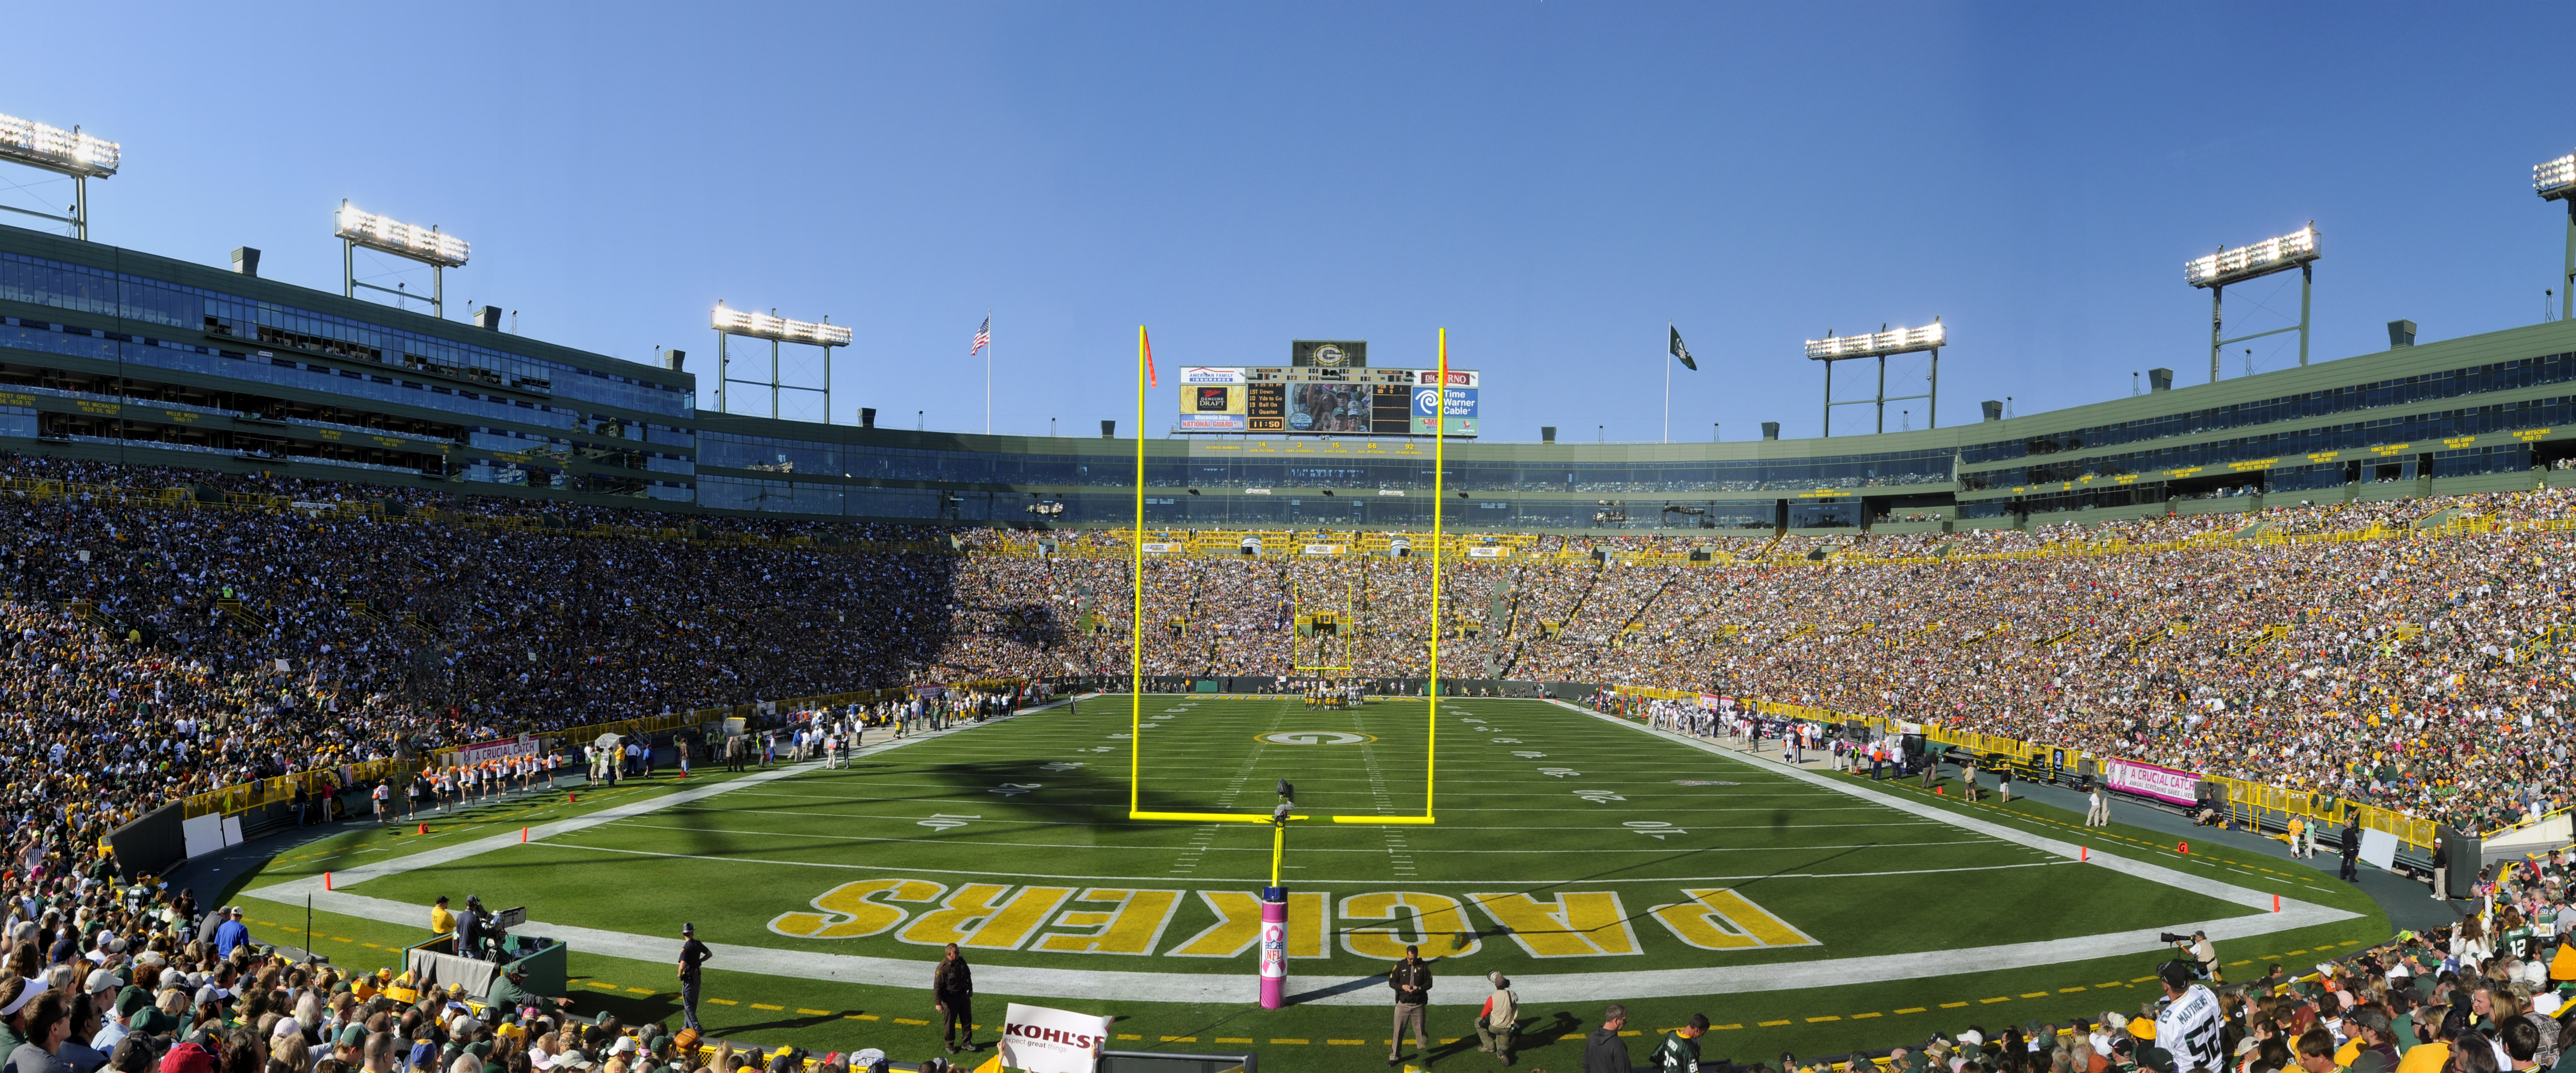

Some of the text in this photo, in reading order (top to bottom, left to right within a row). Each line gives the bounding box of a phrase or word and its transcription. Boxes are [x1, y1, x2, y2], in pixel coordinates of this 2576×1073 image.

[92, 402, 121, 410] MICHALSKE
[1443, 398, 1475, 406] Warner
[476, 751, 480, 761] A
[483, 746, 512, 760] CRUCIAL
[513, 742, 535, 756] CATCH
[2131, 768, 2195, 791] A CRUCIAL CATCH
[2145, 783, 2166, 794] SCREENING
[2168, 788, 2180, 796] SAVES
[2181, 790, 2193, 799] LIVES
[916, 814, 981, 827] 10
[1622, 821, 1688, 834] 10
[422, 823, 428, 833] G
[2179, 843, 2185, 852] G
[767, 878, 1823, 961] PACKERS
[1267, 949, 1281, 960] NFL
[2510, 938, 2526, 958] 12
[2177, 995, 2209, 1025] MATTHEWS
[1005, 1023, 1091, 1049] KOHL'S
[2184, 1014, 2221, 1069] 52
[1027, 1039, 1046, 1048] great
[1048, 1043, 1066, 1053] things
[1668, 1039, 1678, 1052] DRIVER
